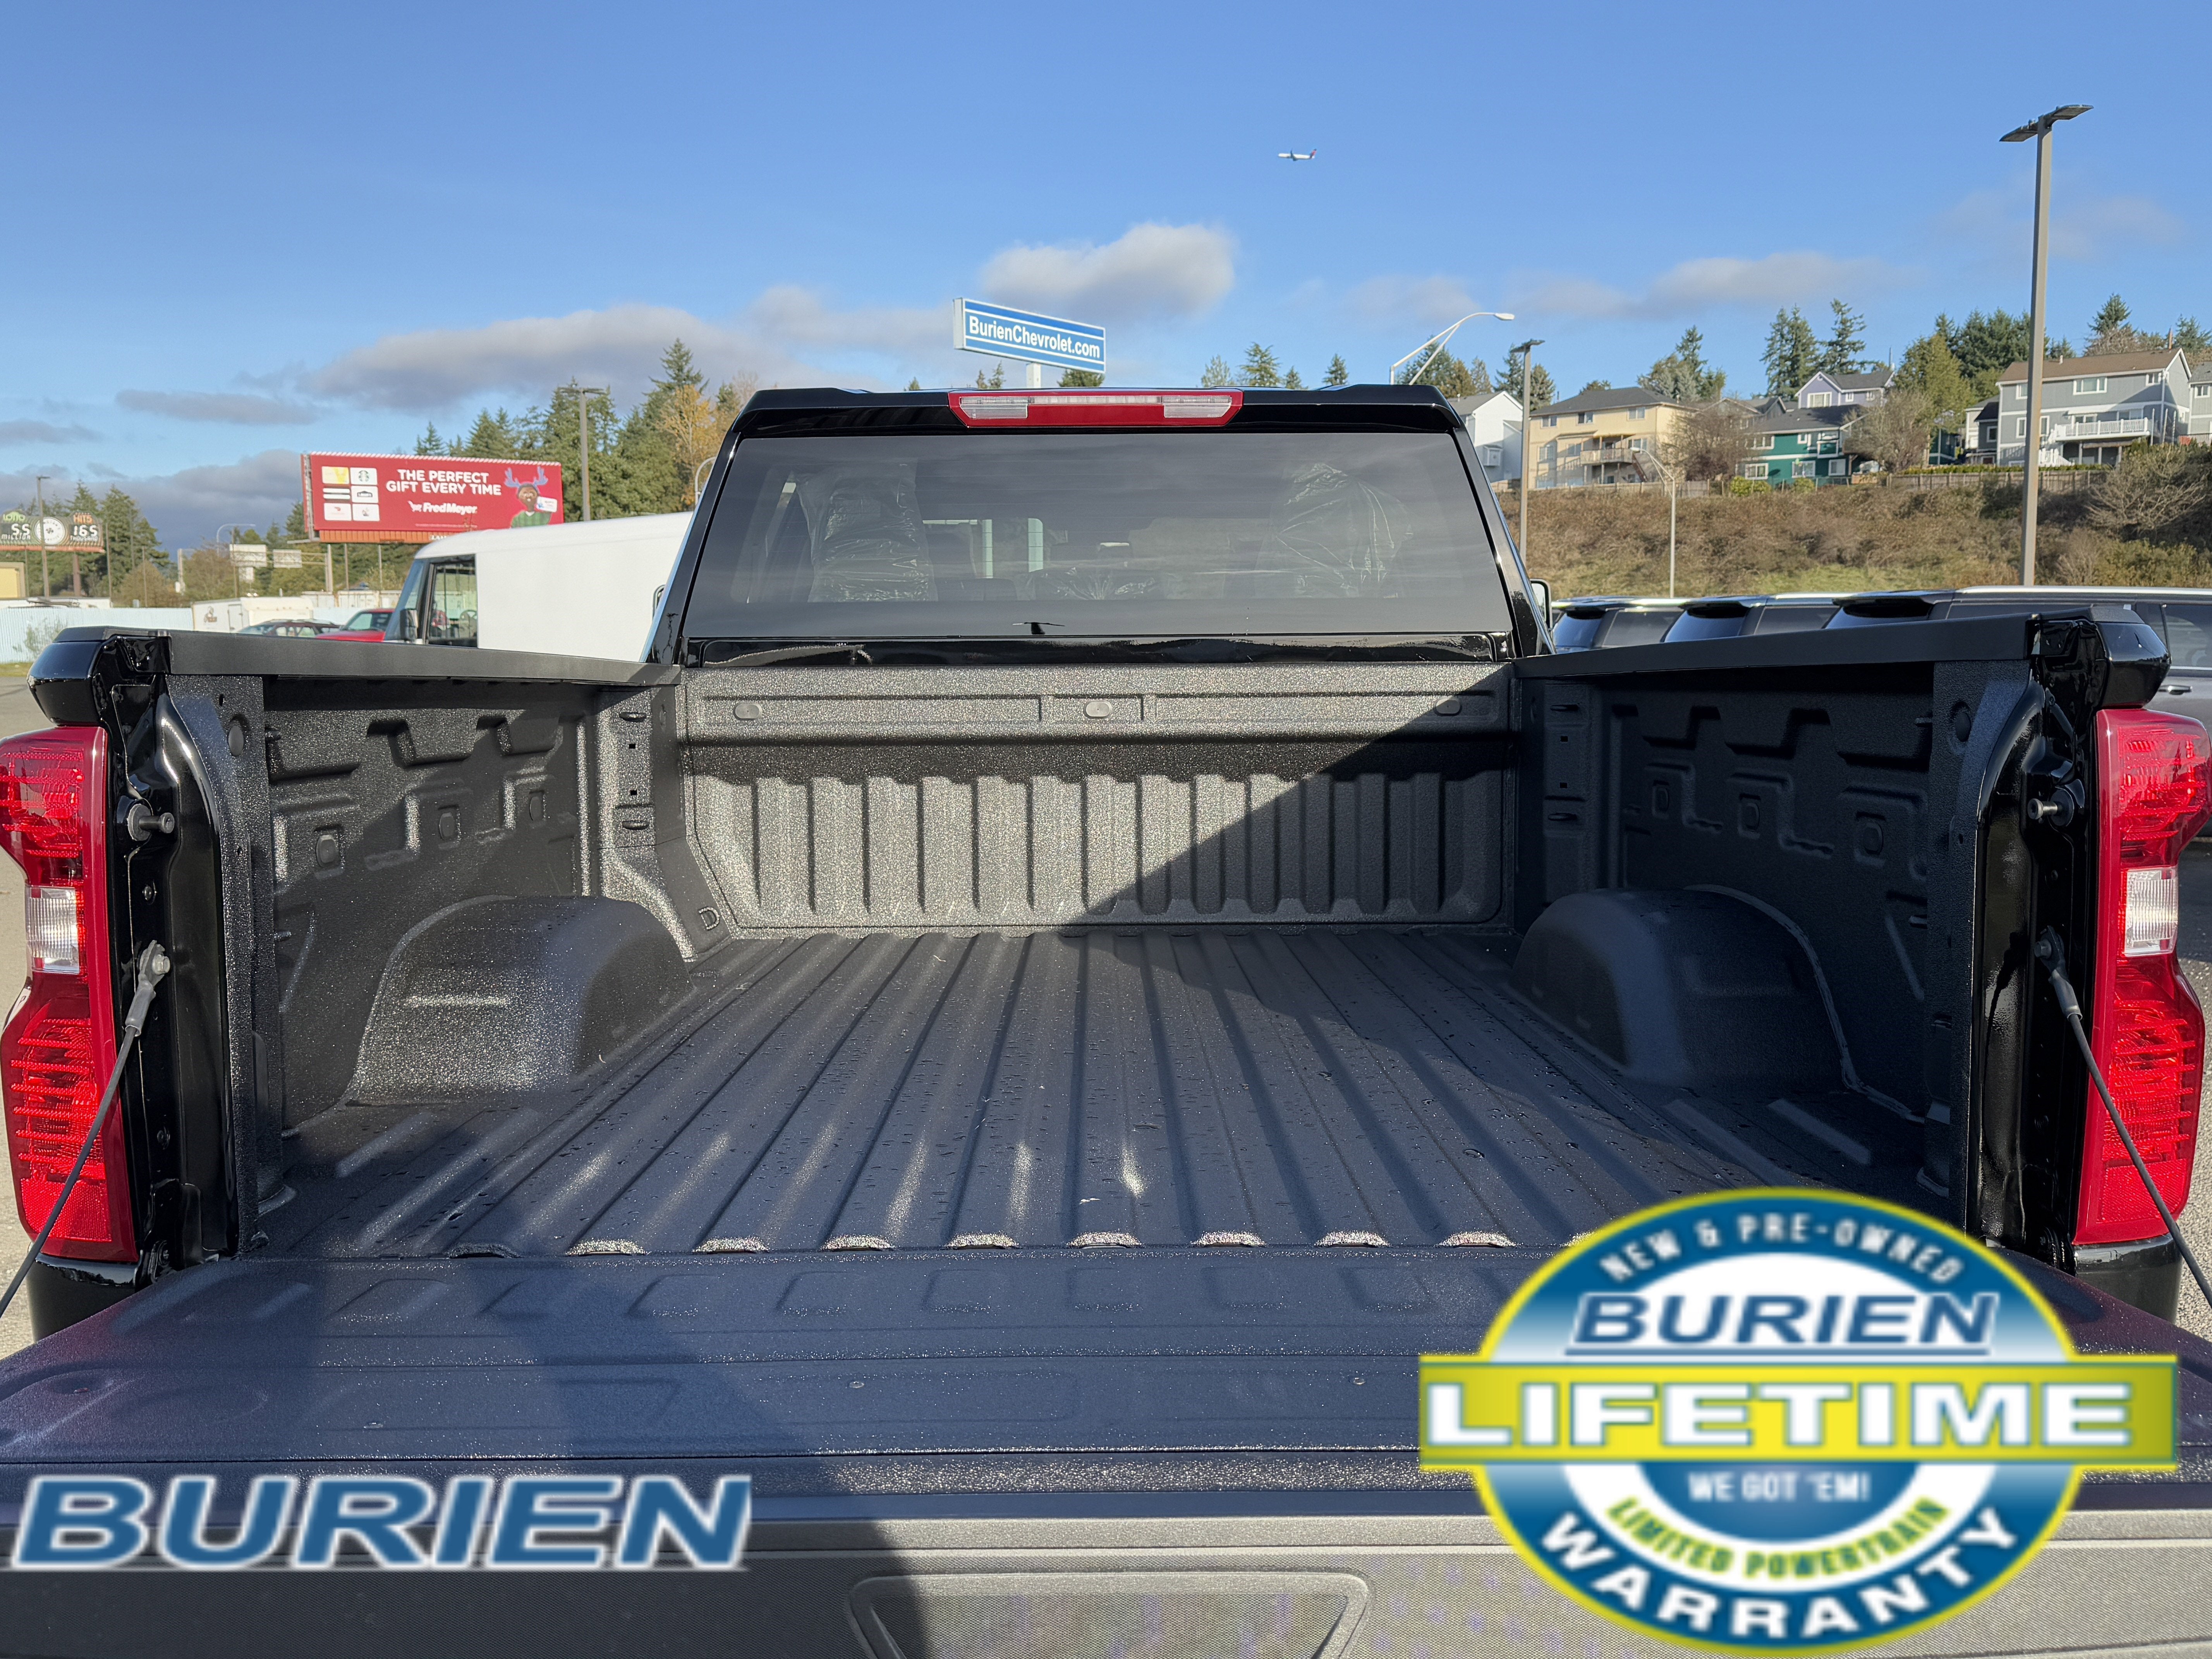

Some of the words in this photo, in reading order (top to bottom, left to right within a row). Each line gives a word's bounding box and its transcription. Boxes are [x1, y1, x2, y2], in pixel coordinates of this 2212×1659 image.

[969, 316, 1100, 358] BurienChevrolet.com
[397, 469, 425, 481] THE
[429, 470, 489, 483] PERFECT
[386, 481, 418, 492] GIFT
[422, 482, 466, 494] EVERY
[470, 483, 501, 495] TIME
